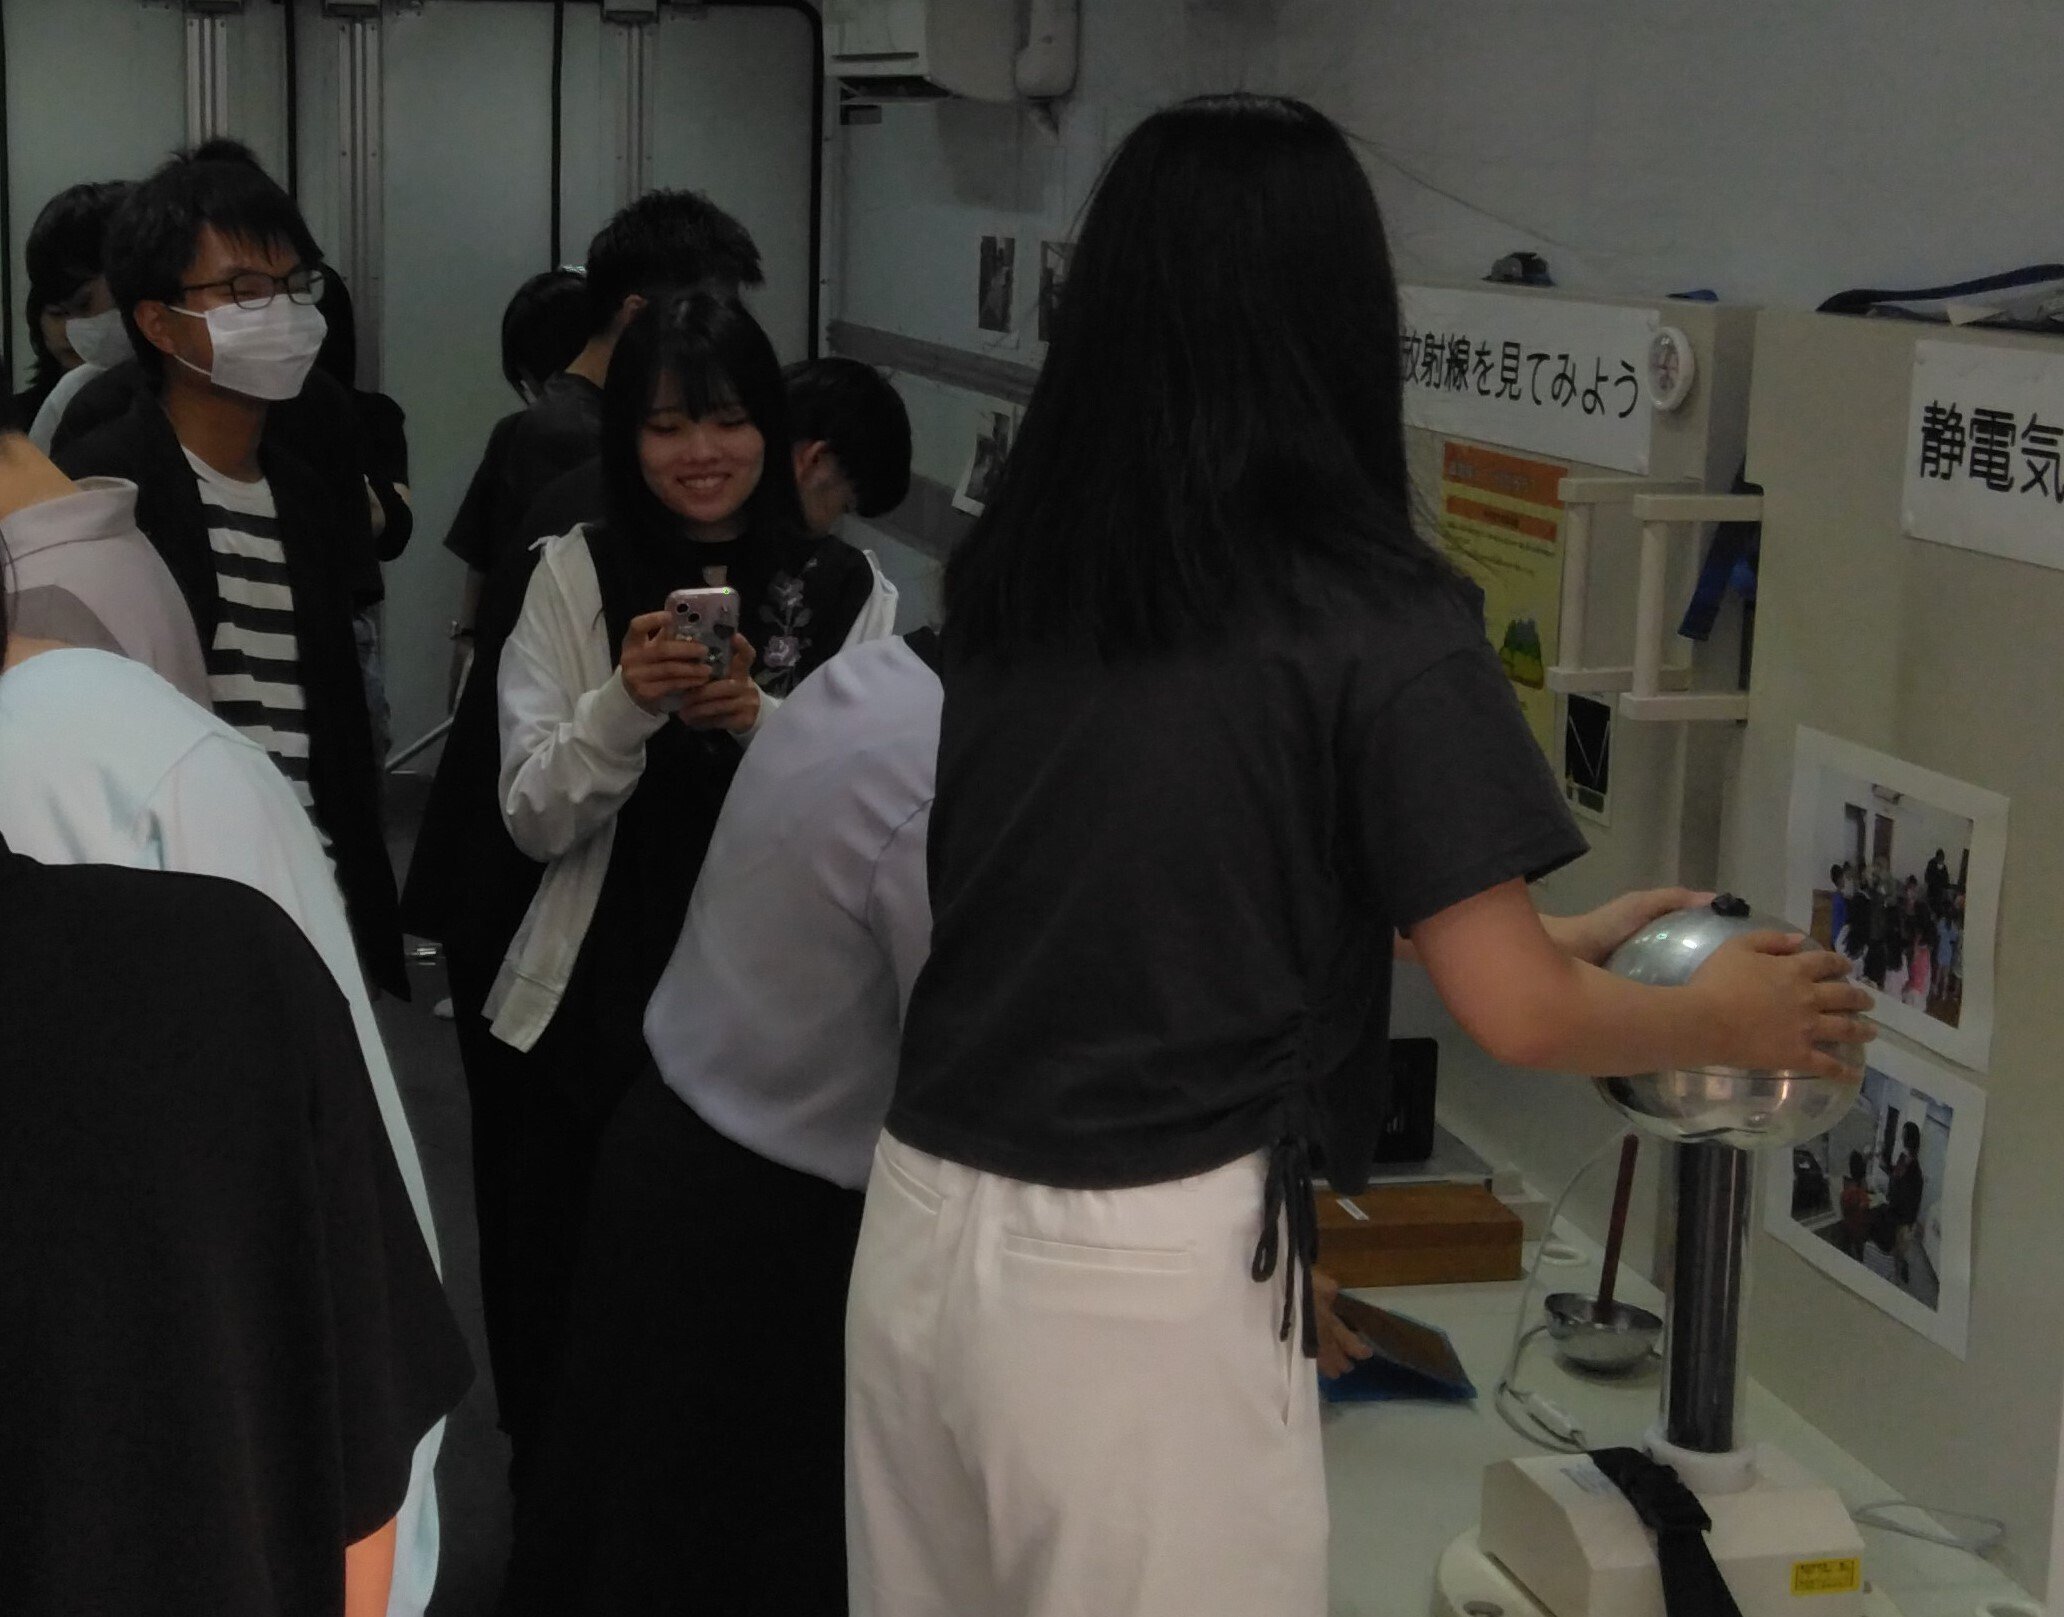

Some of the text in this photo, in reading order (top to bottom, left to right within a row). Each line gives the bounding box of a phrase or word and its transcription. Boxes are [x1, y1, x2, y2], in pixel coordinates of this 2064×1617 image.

[1401, 330, 1638, 418] 放射線を見てみよう
[1920, 400, 2064, 504] 静電気
